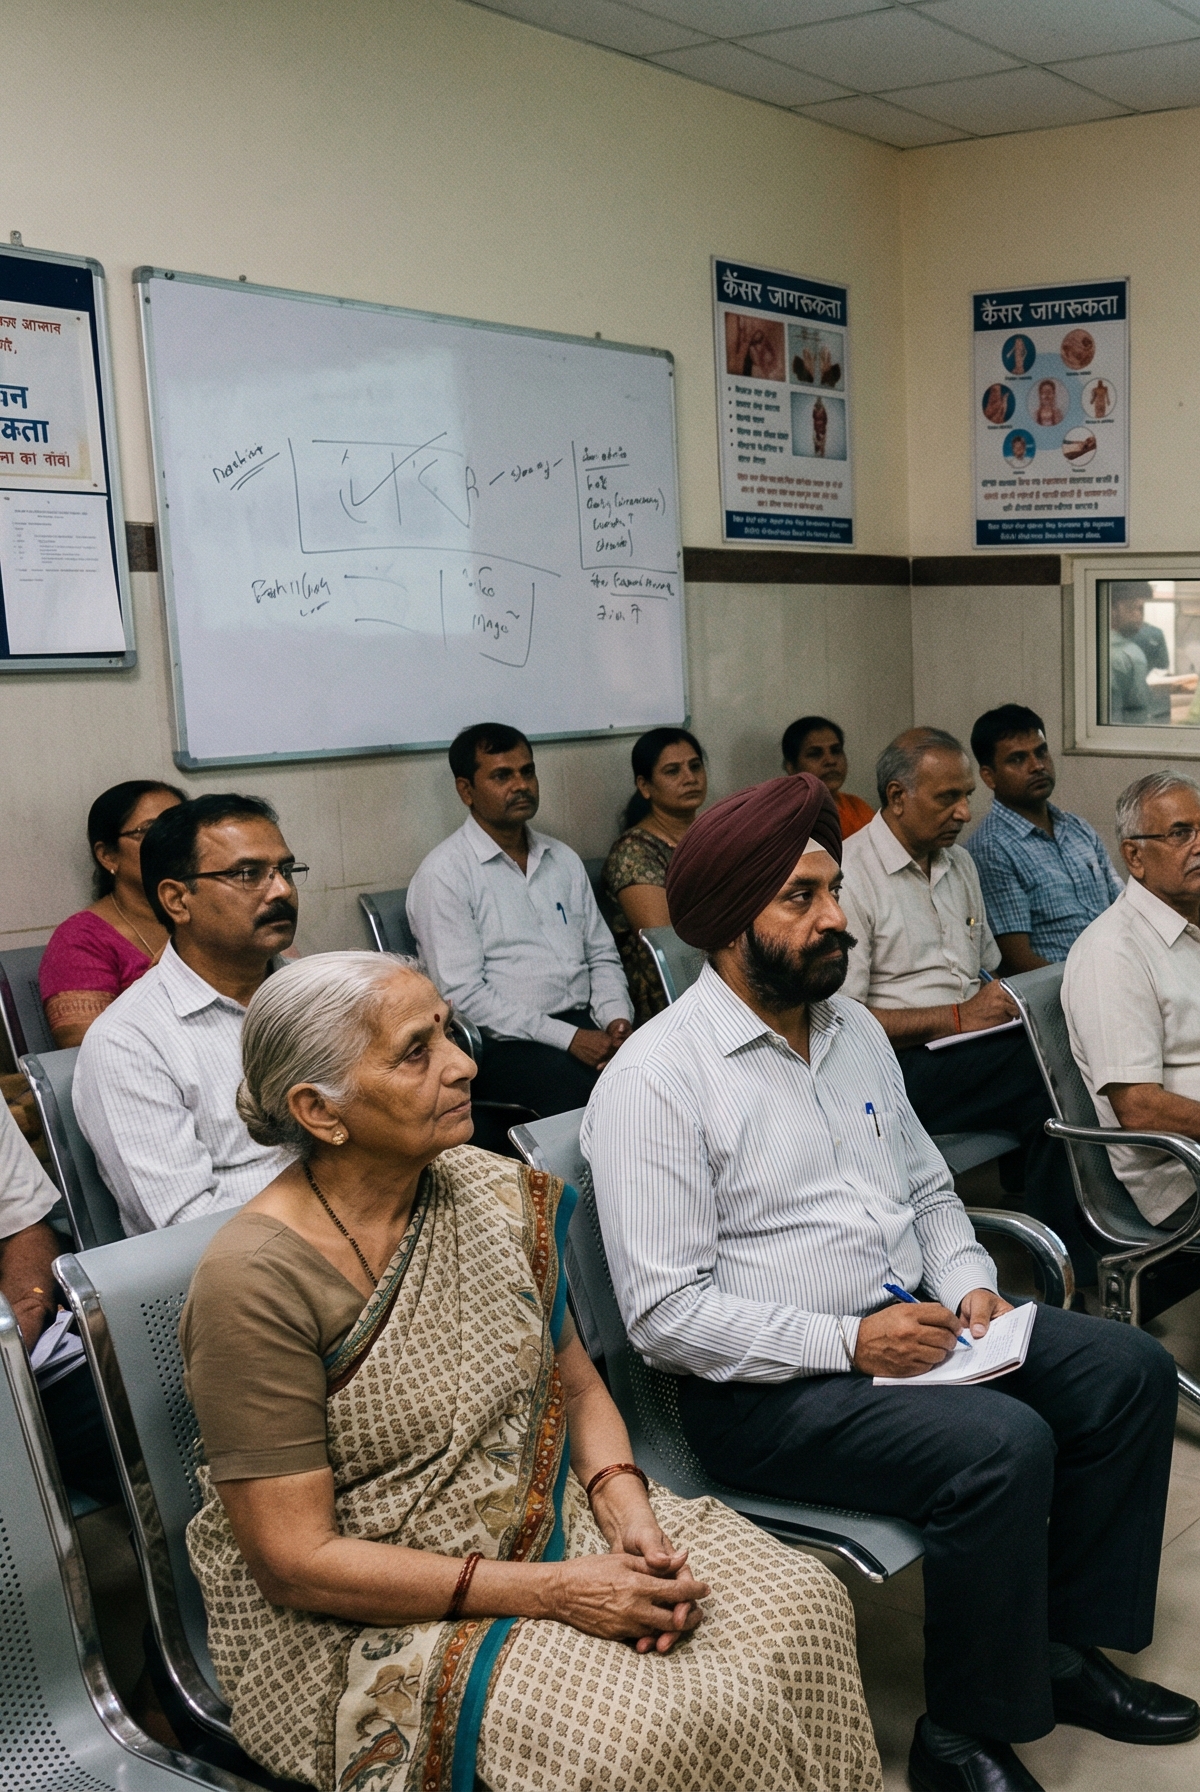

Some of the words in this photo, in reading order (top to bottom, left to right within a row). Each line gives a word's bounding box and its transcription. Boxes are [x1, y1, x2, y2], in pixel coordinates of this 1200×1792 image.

[722, 267, 763, 304] कैंसर
[980, 298, 1024, 325] कैंसर
[0, 416, 49, 444] कता
